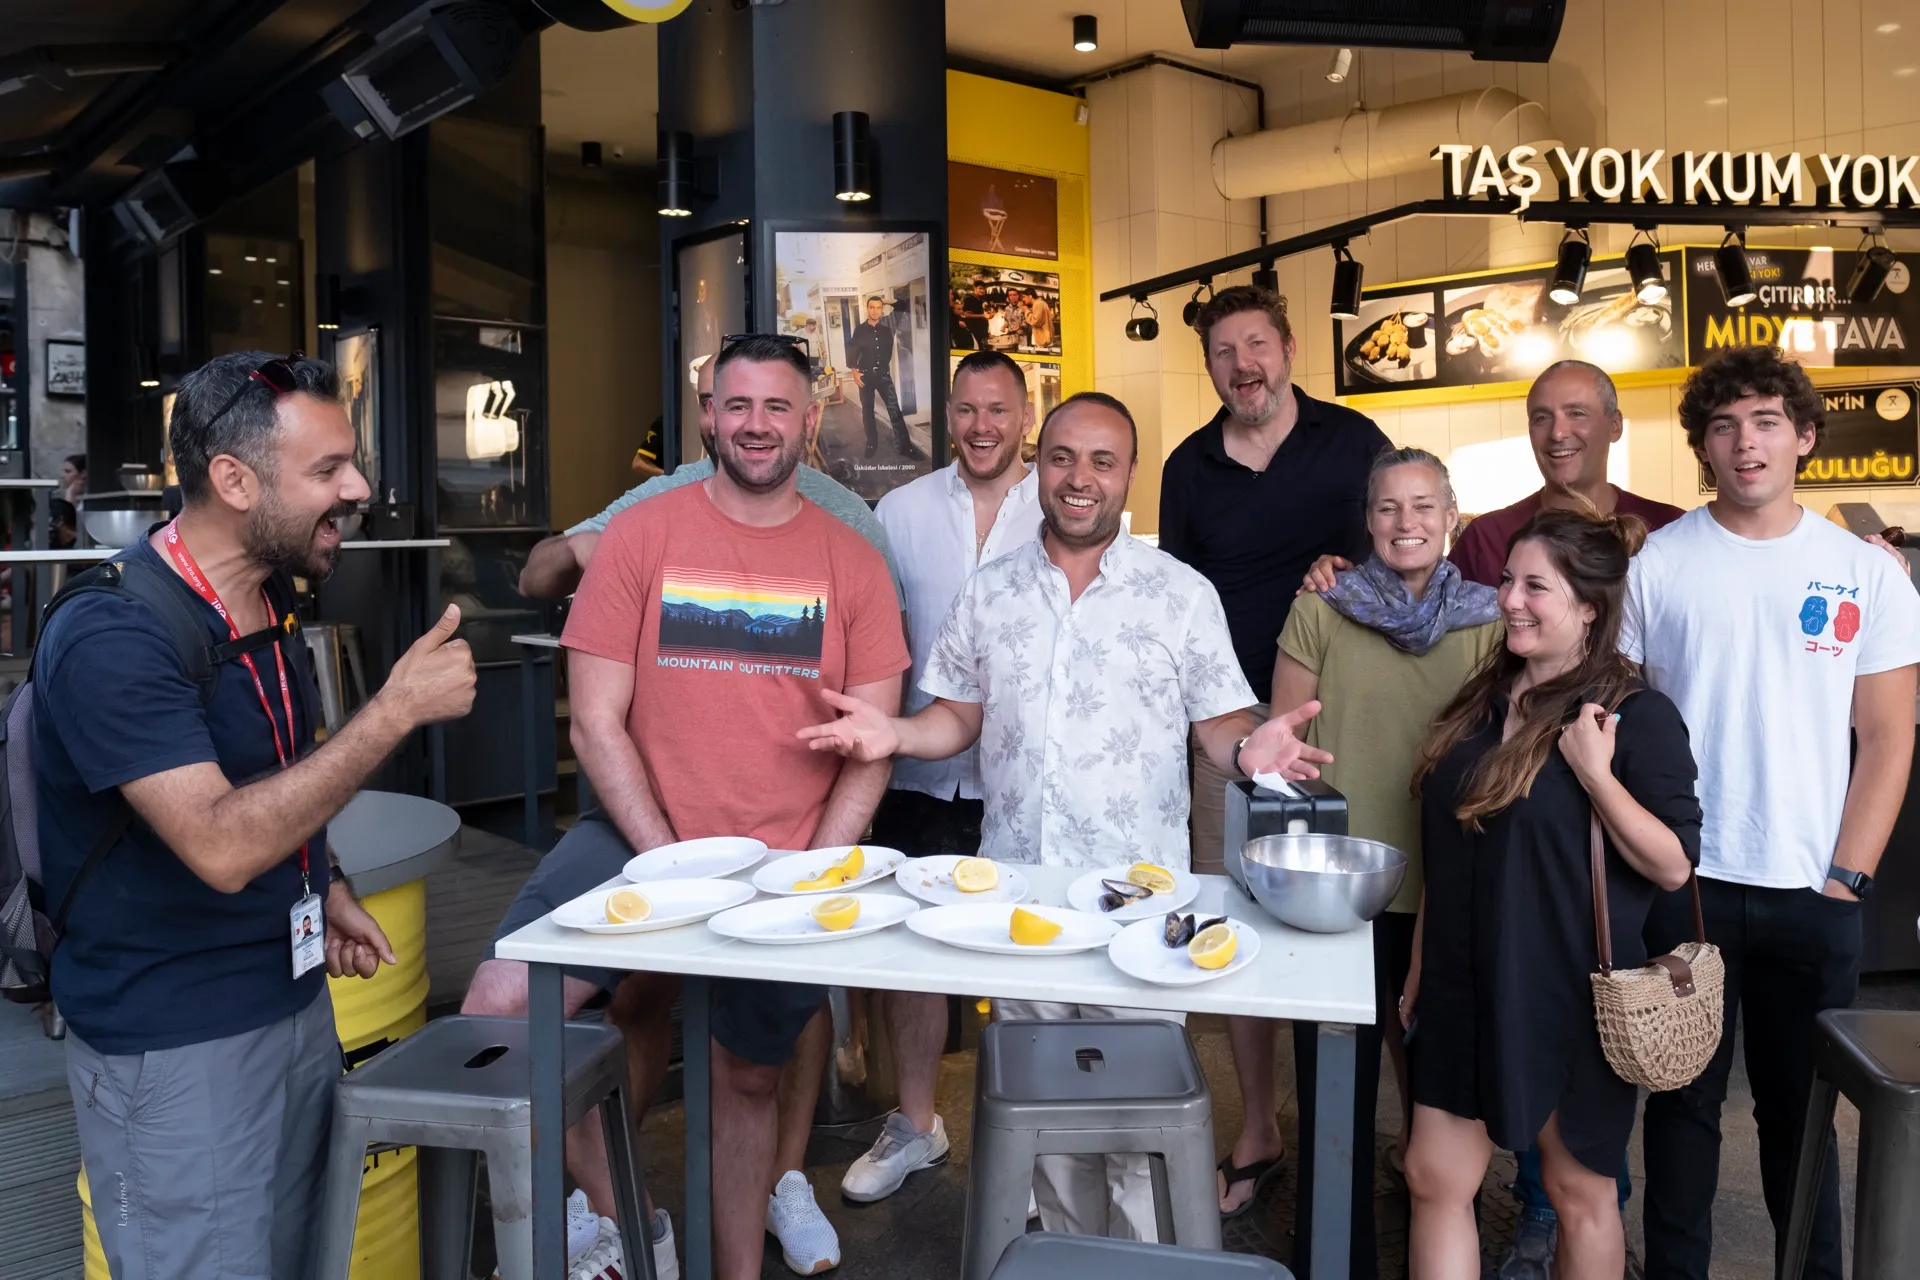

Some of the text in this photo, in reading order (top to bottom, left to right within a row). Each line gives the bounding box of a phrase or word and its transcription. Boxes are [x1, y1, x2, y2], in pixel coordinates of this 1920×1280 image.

[1438, 144, 1920, 214] TAŞ YOK KUM YOK
[1757, 267, 1781, 280] YOK!
[1821, 315, 1906, 351] TAVA
[177, 551, 207, 593] www.iro.org.tr
[1804, 640, 1844, 657] コーツ
[657, 655, 820, 679] MOUNTAIN OUTFITTERS
